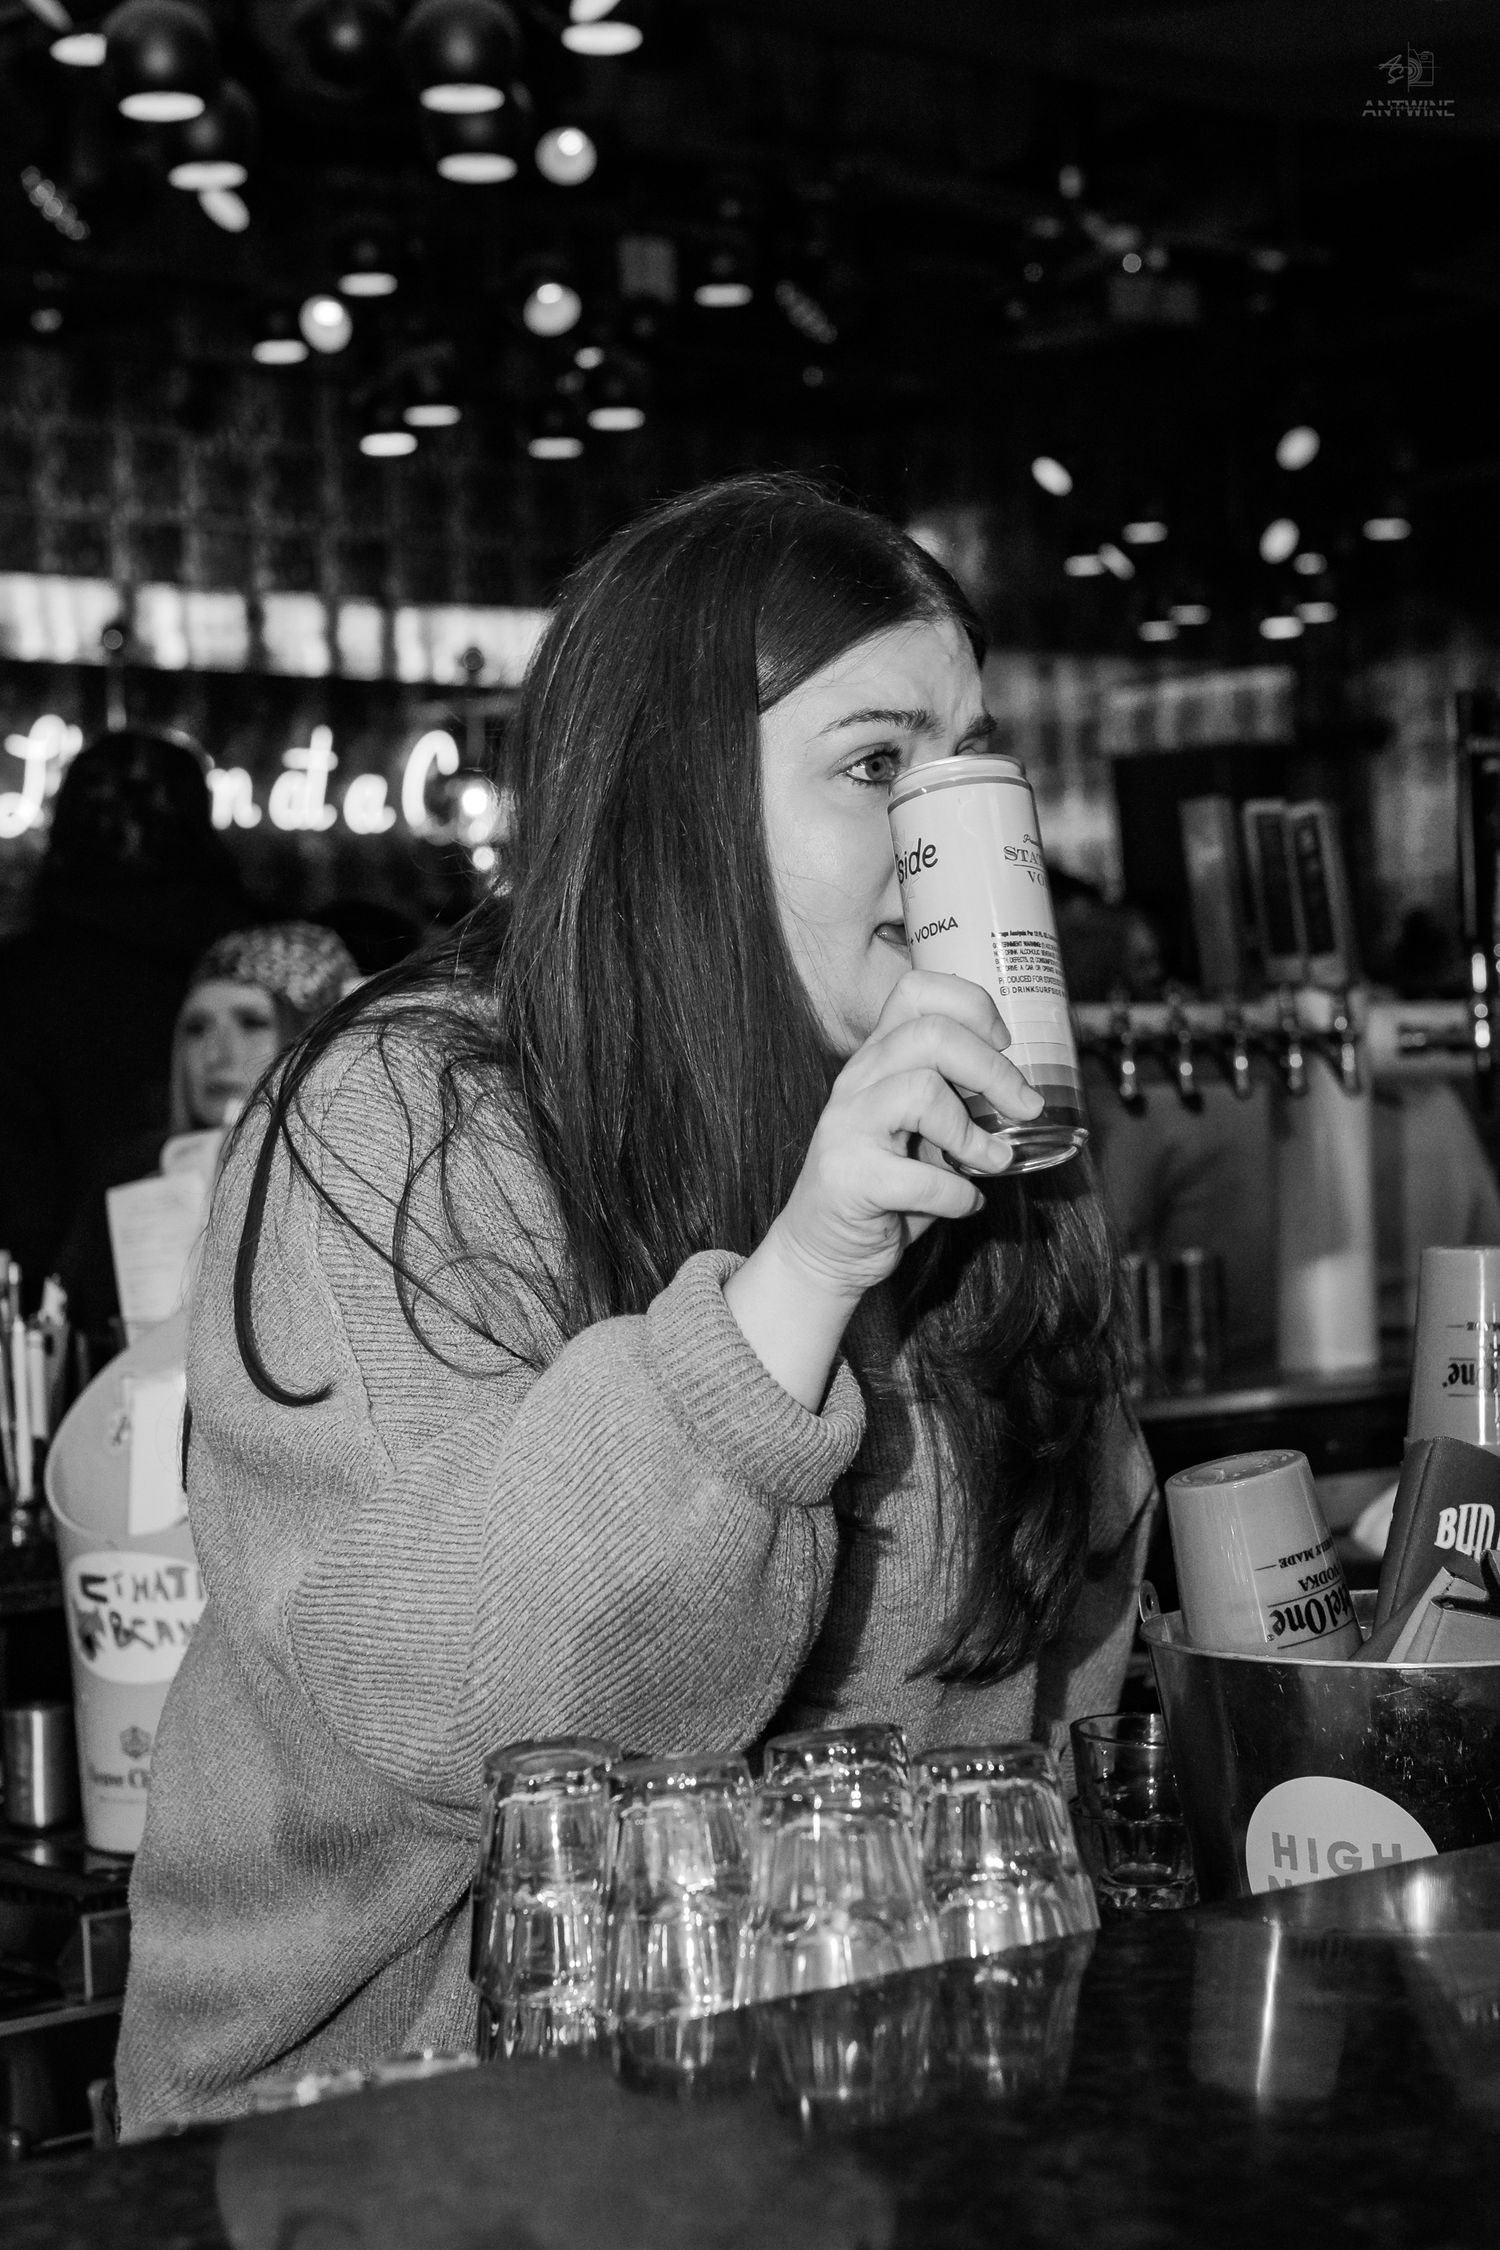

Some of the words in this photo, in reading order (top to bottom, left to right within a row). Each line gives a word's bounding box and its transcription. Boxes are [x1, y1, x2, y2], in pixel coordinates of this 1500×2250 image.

[1027, 870, 1047, 888] VO
[914, 916, 959, 944] VODKA
[1434, 1503, 1496, 1565] BUD
[1278, 1547, 1313, 1569] MADE
[1271, 1831, 1403, 1876] HIGH
